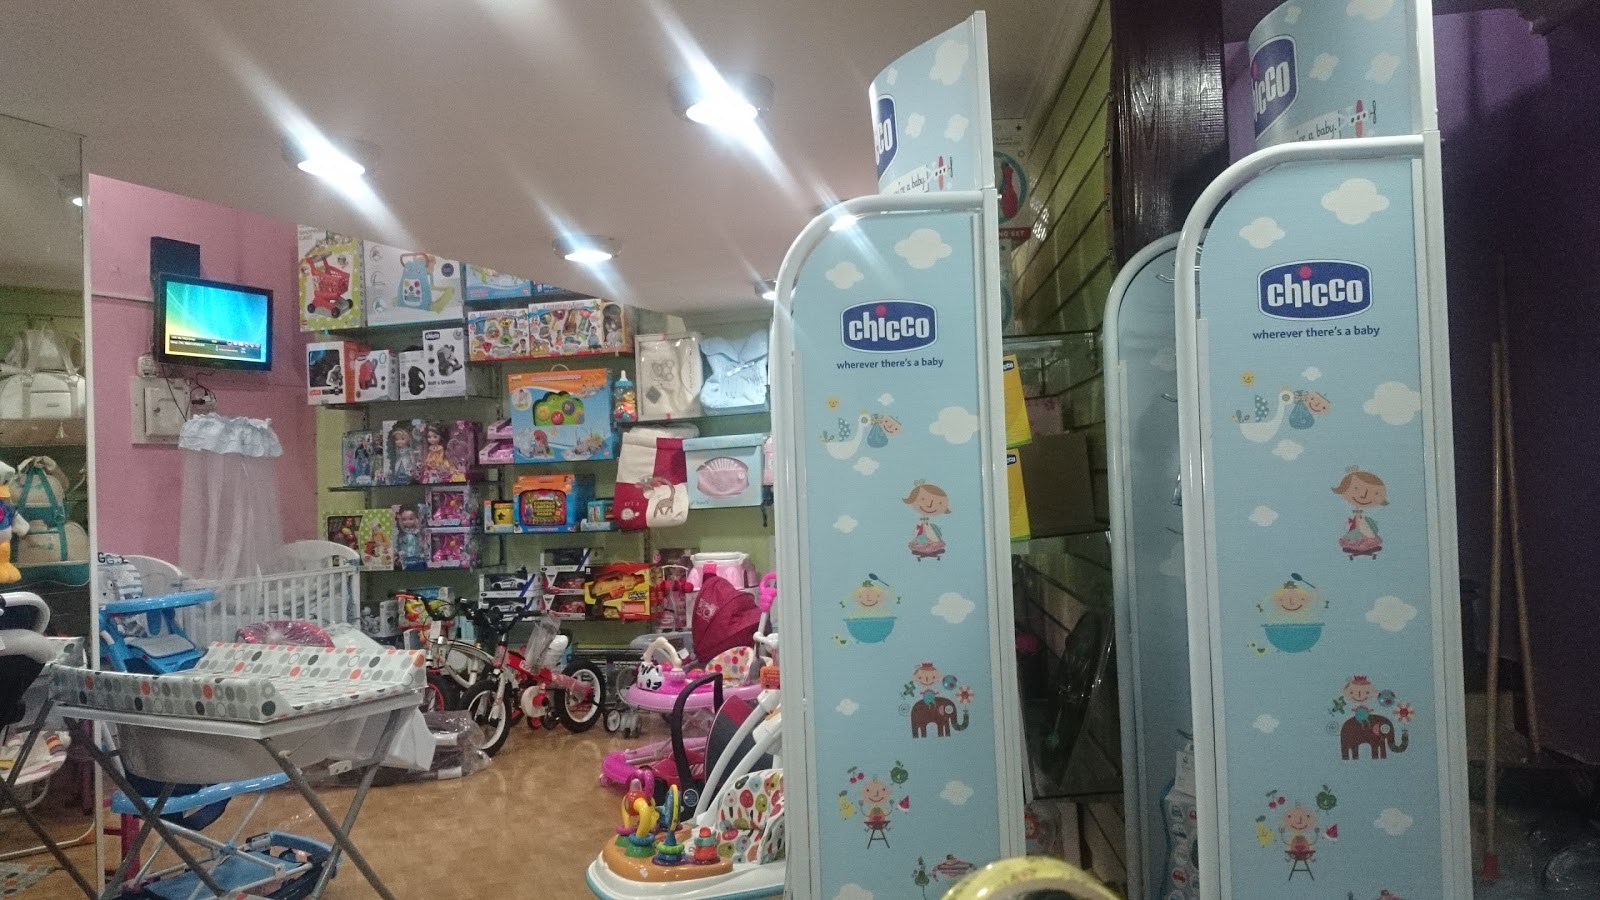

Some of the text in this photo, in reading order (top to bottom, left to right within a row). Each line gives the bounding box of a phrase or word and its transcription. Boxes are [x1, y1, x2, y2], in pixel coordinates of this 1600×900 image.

[1267, 265, 1364, 308] chicco
[848, 304, 930, 342] chicco
[1252, 325, 1380, 340] wherever there's a baby
[836, 360, 879, 370] wherever
[881, 358, 912, 368] there's
[921, 357, 944, 368] baby
